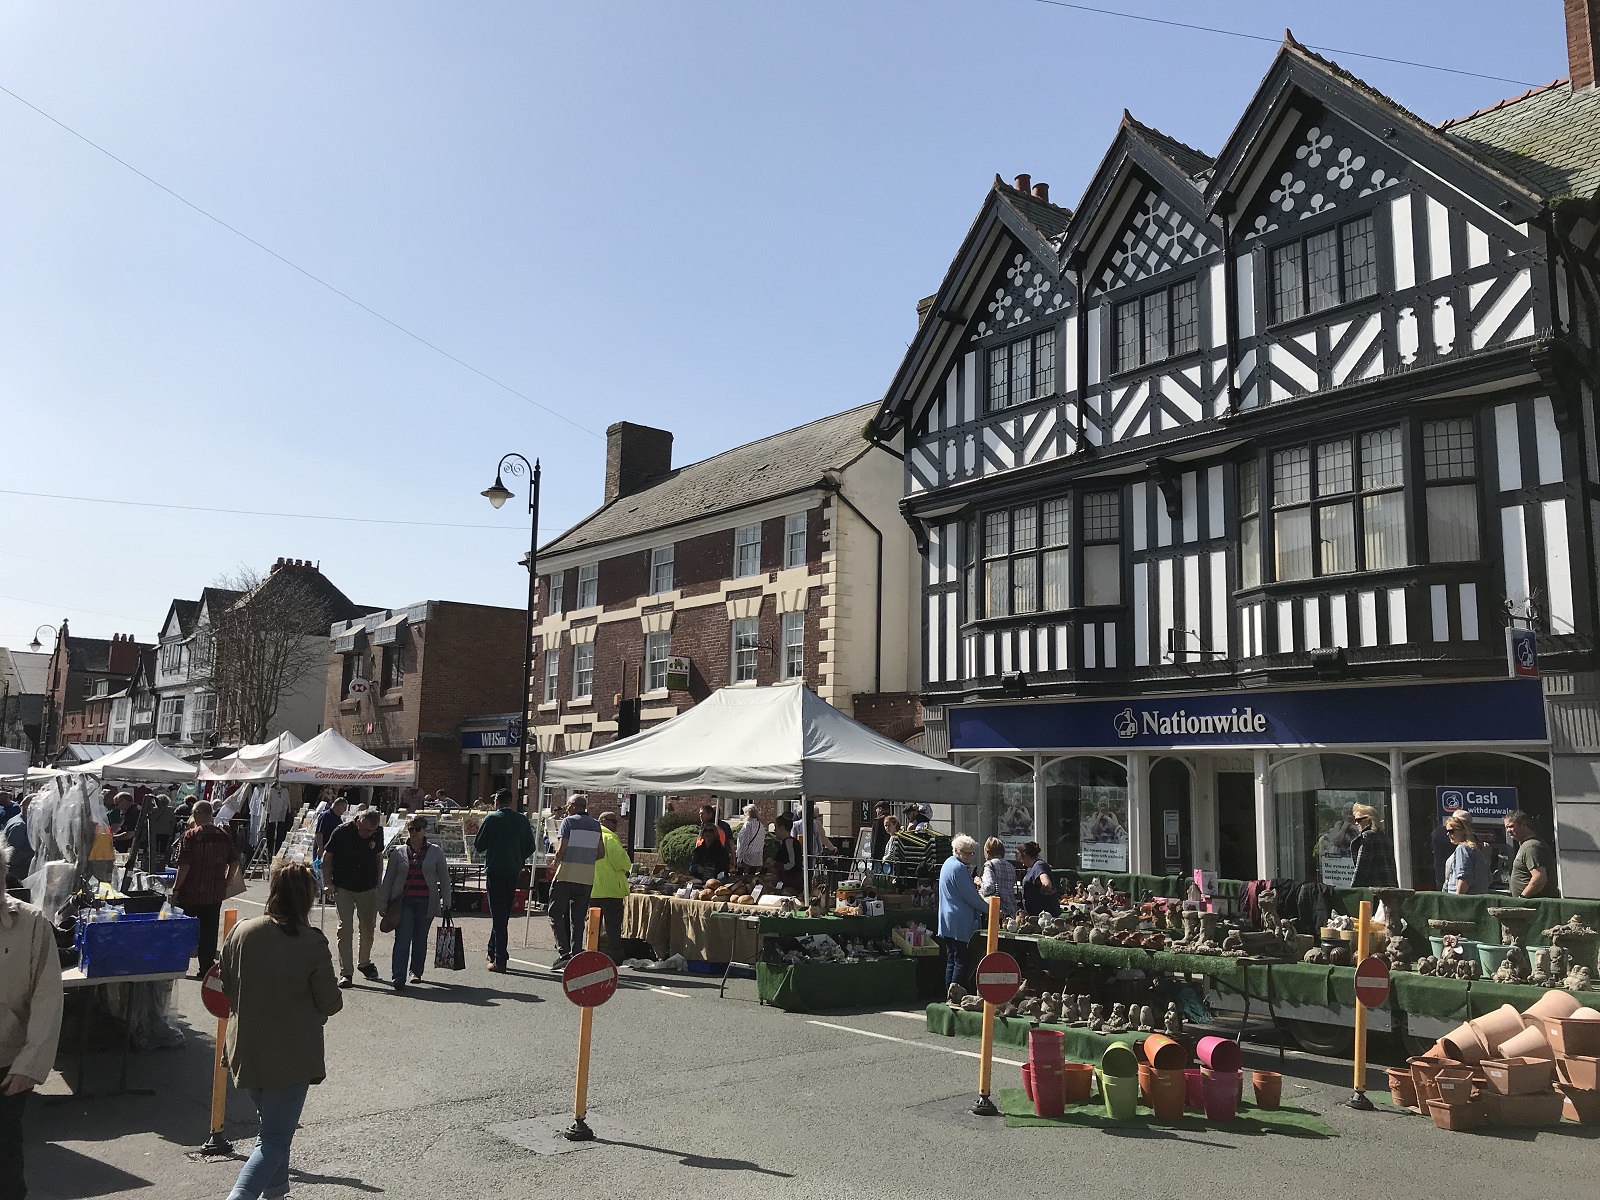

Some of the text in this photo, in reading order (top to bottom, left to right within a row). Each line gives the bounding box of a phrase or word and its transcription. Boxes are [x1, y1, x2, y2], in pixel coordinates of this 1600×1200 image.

[1141, 707, 1266, 735] Nationwide
[481, 732, 507, 746] WHSm
[314, 771, 357, 780] Continental
[359, 771, 385, 780] Fashion
[1466, 791, 1499, 805] Cash
